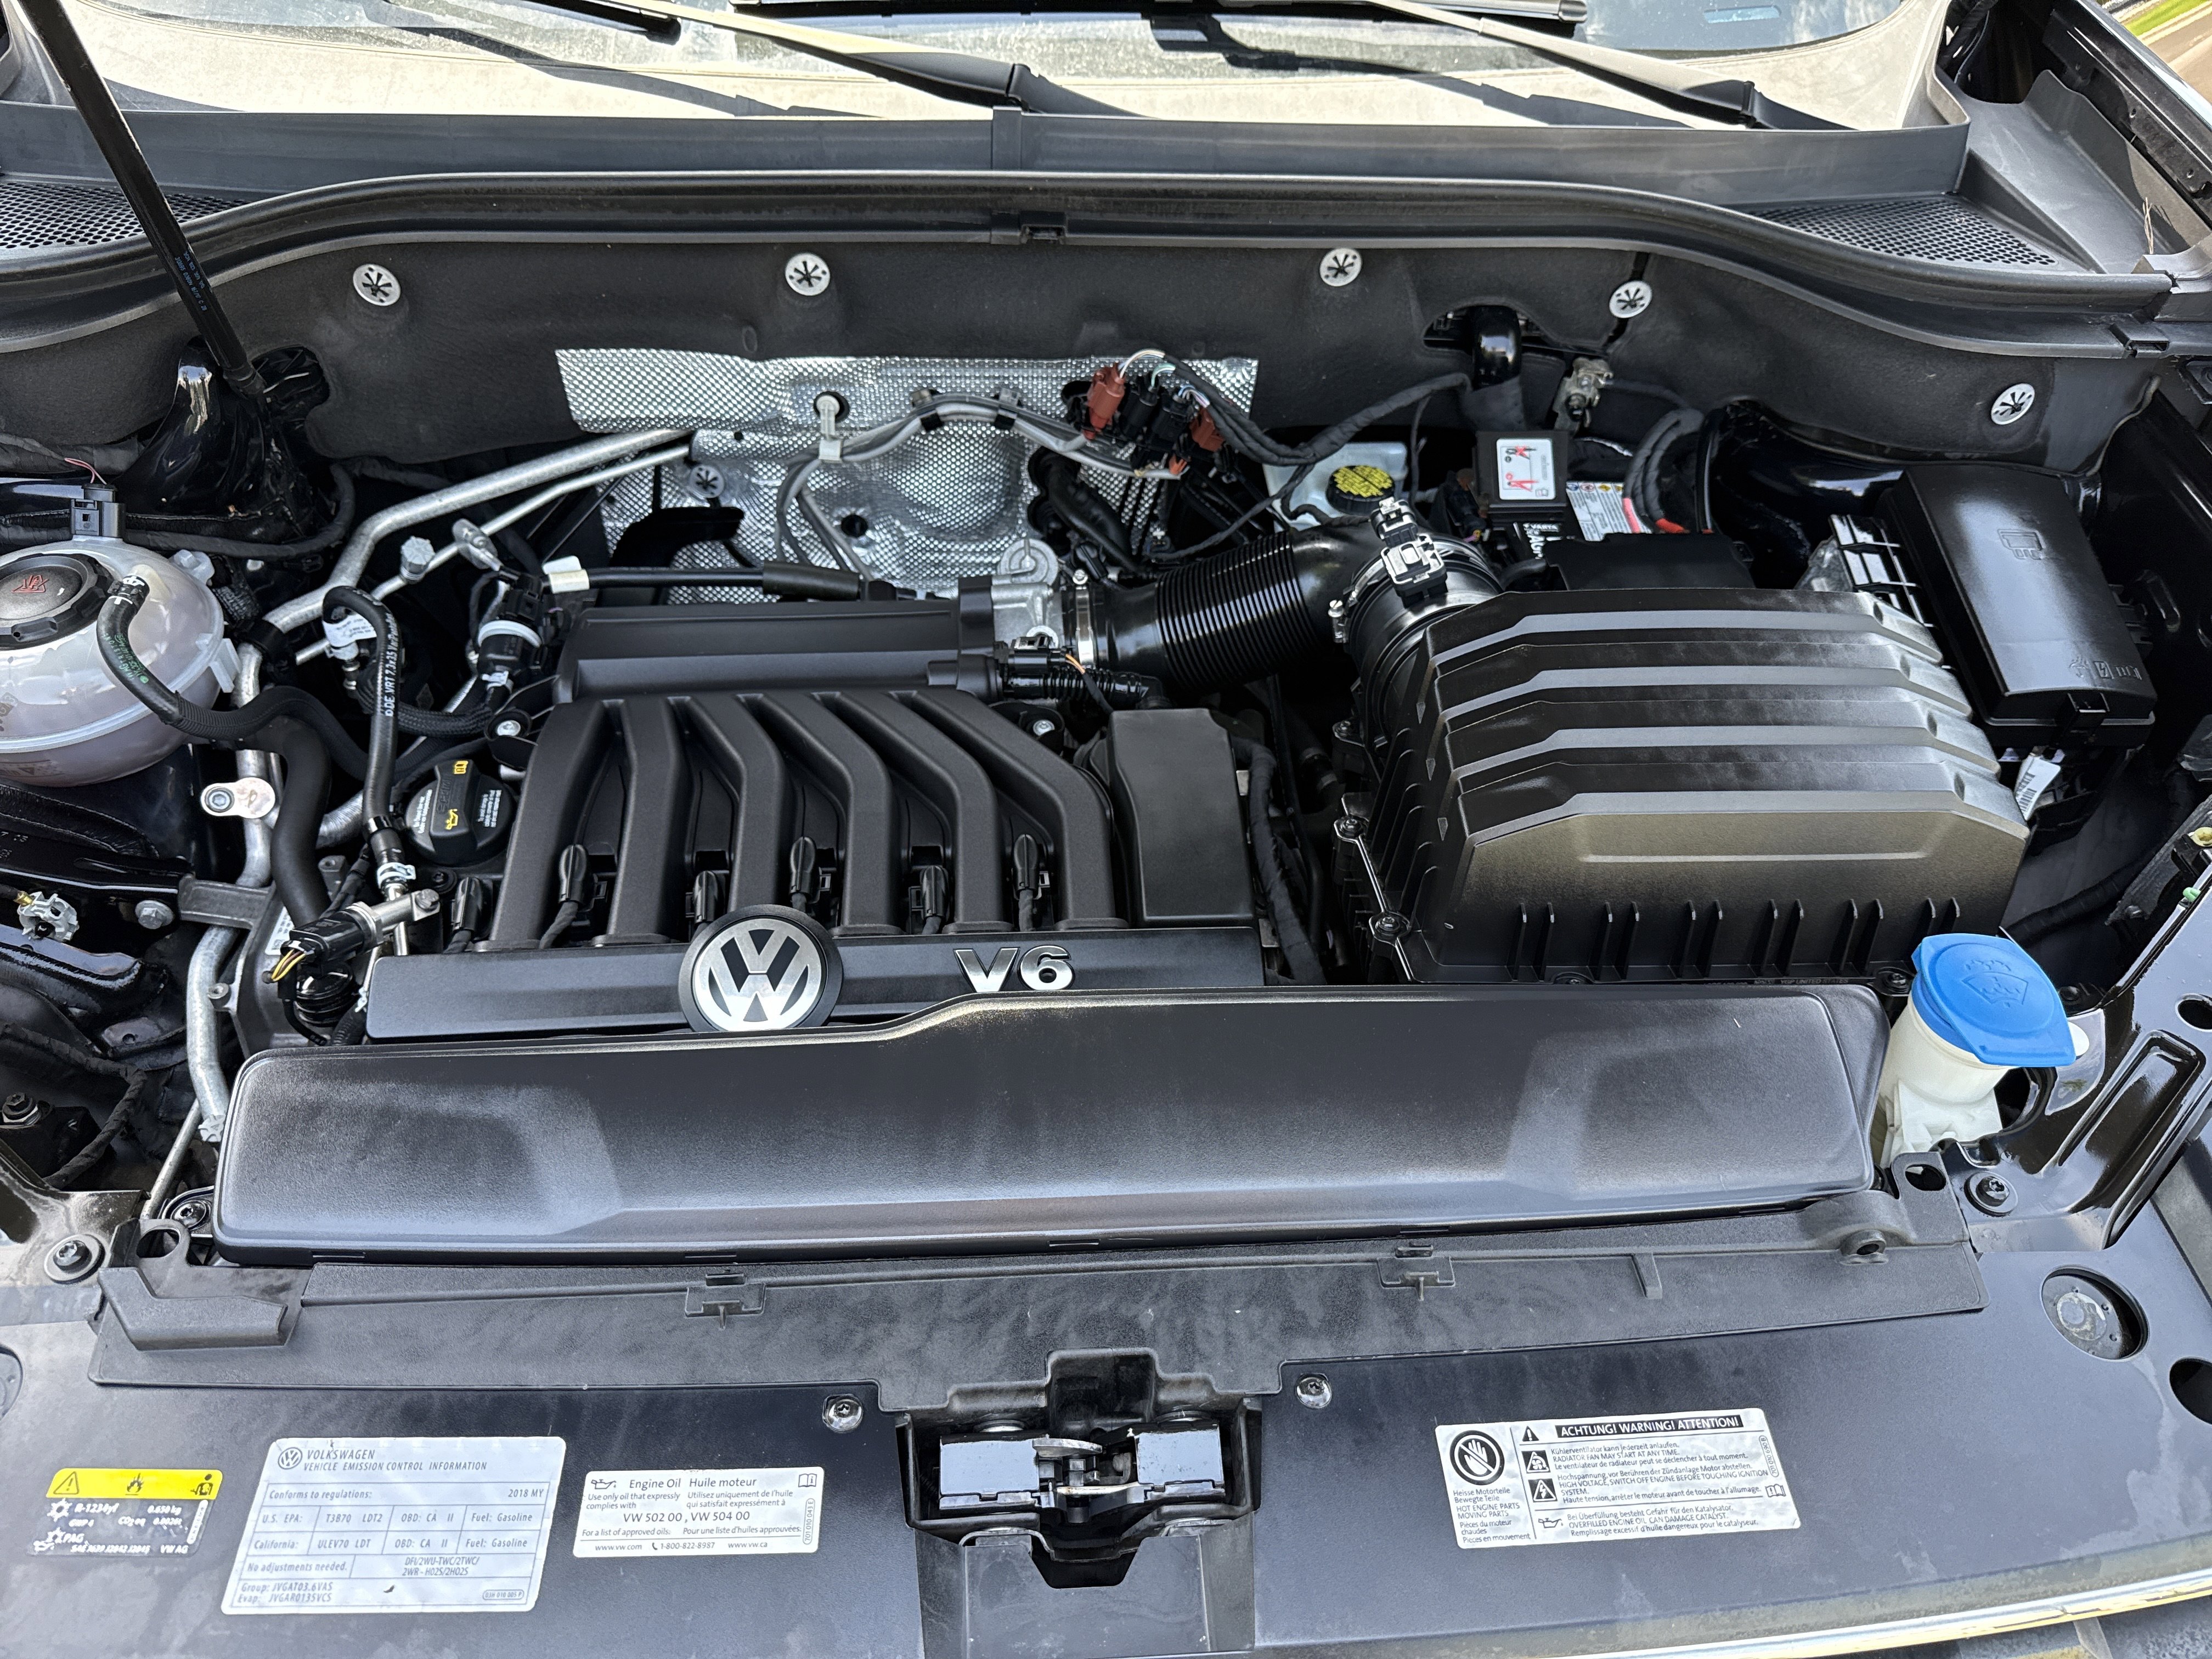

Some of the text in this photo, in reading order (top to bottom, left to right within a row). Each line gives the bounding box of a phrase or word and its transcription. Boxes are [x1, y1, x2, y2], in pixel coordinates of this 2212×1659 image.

[954, 945, 1074, 992] V6
[1561, 1417, 1739, 1436] ACHTUNG! WARNING! ATTENTION!
[307, 1449, 375, 1459] VOLKSWAGEN
[1551, 1447, 1602, 1455] Kühlerventilator
[1620, 1444, 1648, 1453] jederzeit
[304, 1462, 487, 1471] VEHICLE EMISSION CONTROL INFORMATION
[1662, 1466, 1699, 1475] Zündanlage
[629, 1478, 757, 1491] Engine Oil Huile moteur
[270, 1489, 372, 1500] Conforms regulations:
[508, 1489, 528, 1497] 2018
[603, 1493, 619, 1502] only
[647, 1493, 680, 1502] expressly
[716, 1491, 759, 1500] uniquement
[586, 1503, 618, 1511] complies
[687, 1501, 698, 1509] qui
[730, 1499, 780, 1508] expressément
[263, 1515, 278, 1523] U.S.
[326, 1514, 351, 1522] T3B70
[363, 1514, 382, 1522] LDT2
[402, 1514, 421, 1522] OBD:
[471, 1513, 492, 1522] Fuel:
[497, 1513, 533, 1521] Gasoline
[624, 1511, 750, 1522] VW 502 00 VW 504 00
[1569, 1520, 1607, 1528] OVERFILLED
[1571, 1528, 1612, 1537] Remplissage
[1724, 1519, 1758, 1527] catalyseur.
[621, 1528, 655, 1537] approved
[63, 1533, 84, 1543] PAG
[255, 1538, 527, 1549] California: ULEV70 LDT OBD: Fuel: Gasoline
[160, 1545, 176, 1553] VW
[175, 1545, 189, 1554] AG
[261, 1562, 347, 1573] adjustments needed.
[241, 1583, 270, 1593] Group:
[238, 1594, 261, 1604] Evap:
